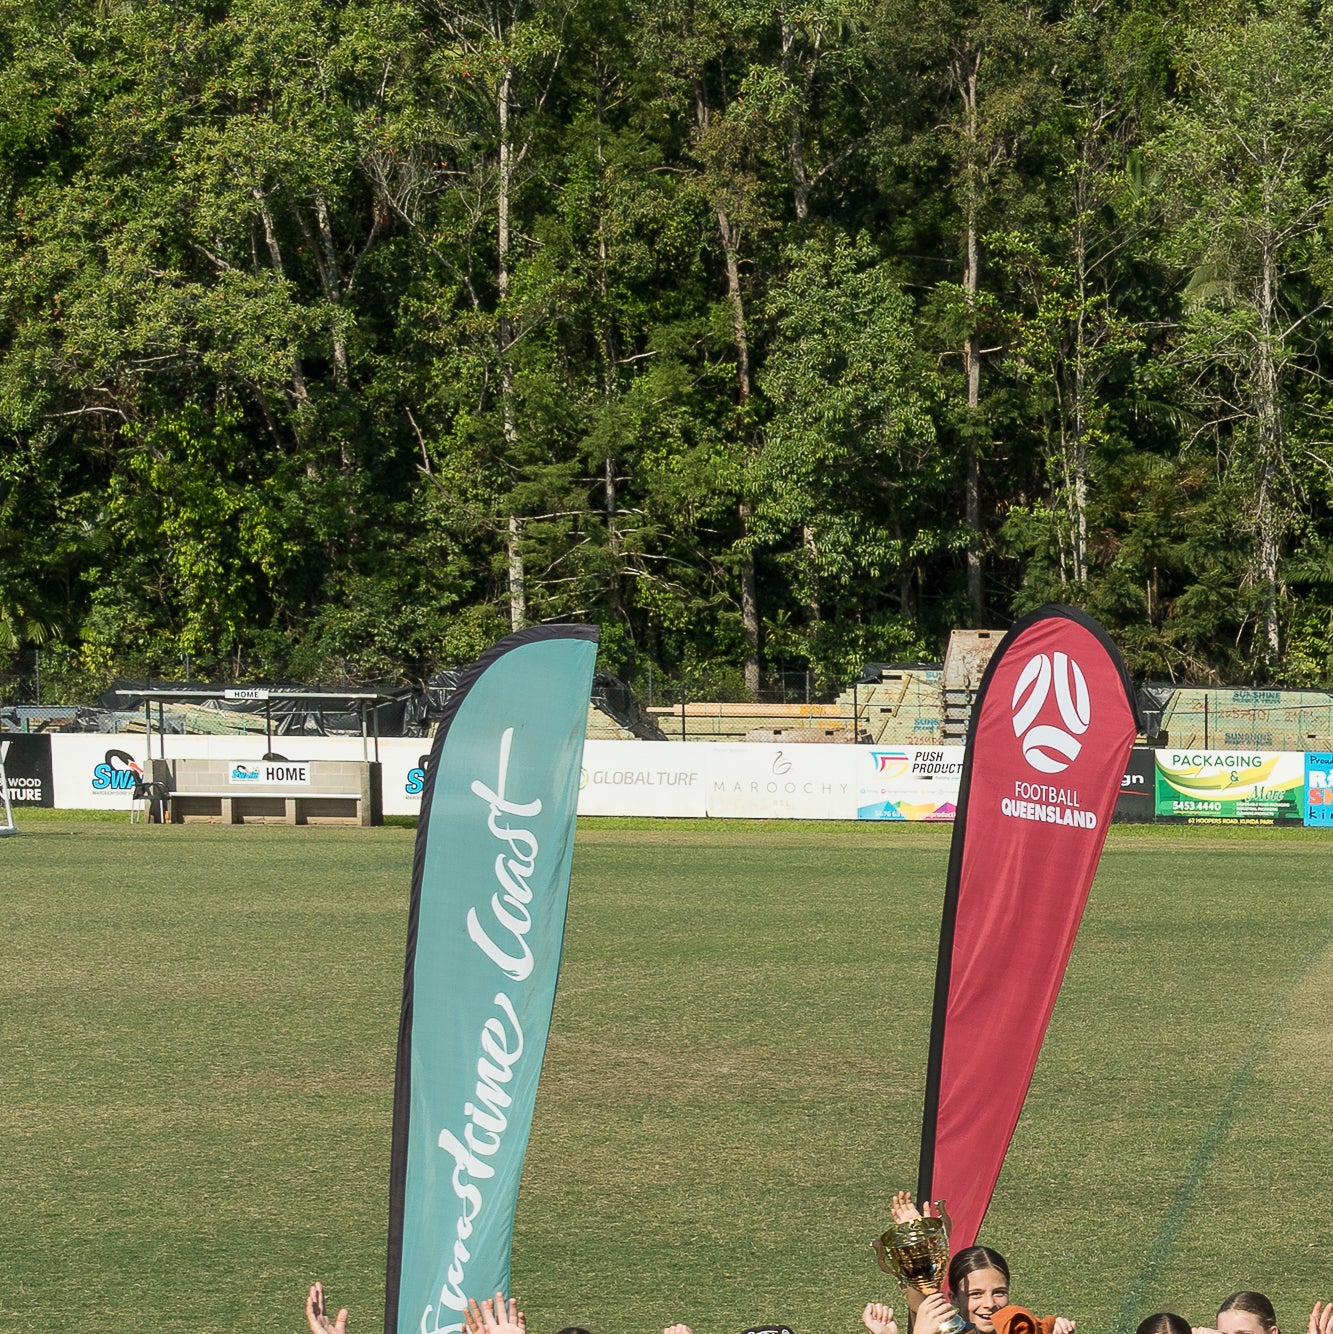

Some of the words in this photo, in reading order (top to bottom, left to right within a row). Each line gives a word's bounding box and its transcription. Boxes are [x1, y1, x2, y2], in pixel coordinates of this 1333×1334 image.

[914, 752, 944, 761] PUSH
[1173, 755, 1262, 767] PACKAGING
[266, 767, 306, 781] HOME
[1230, 771, 1239, 782] &
[8, 777, 42, 788] WOOD
[713, 781, 848, 793] MAROOCHY
[1015, 781, 1080, 807] FOOTBALL
[1001, 797, 1097, 829] QUEENSLAND
[467, 727, 542, 980] Coast
